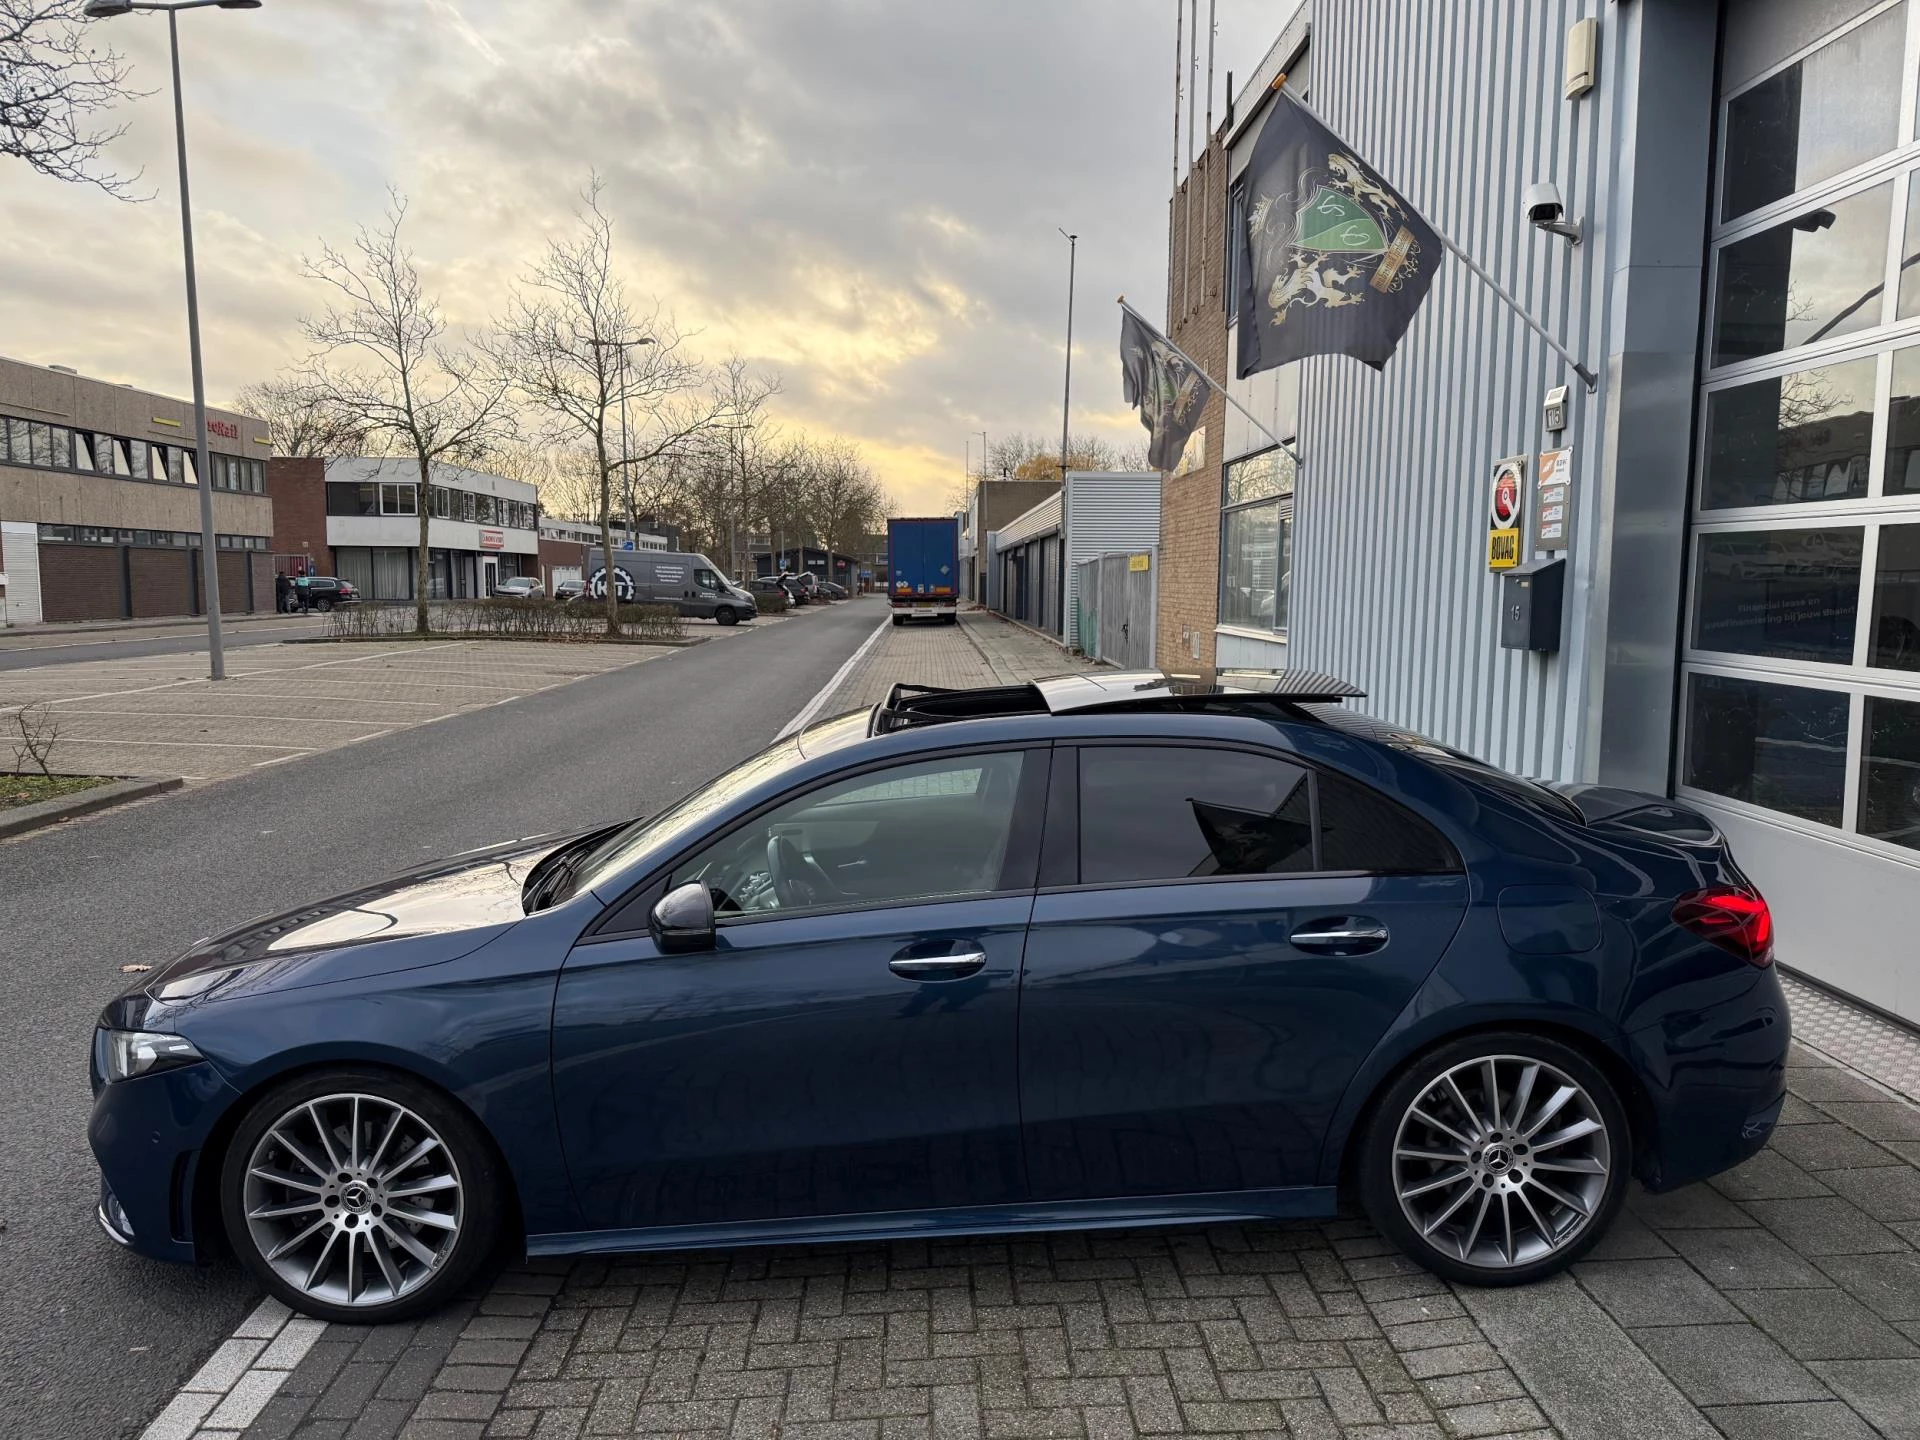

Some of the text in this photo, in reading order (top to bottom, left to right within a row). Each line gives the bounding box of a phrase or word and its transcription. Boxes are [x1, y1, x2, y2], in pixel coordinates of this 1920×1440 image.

[1548, 409, 1560, 426] 15
[1491, 535, 1515, 560] BOVAG
[1511, 605, 1521, 621] 15
